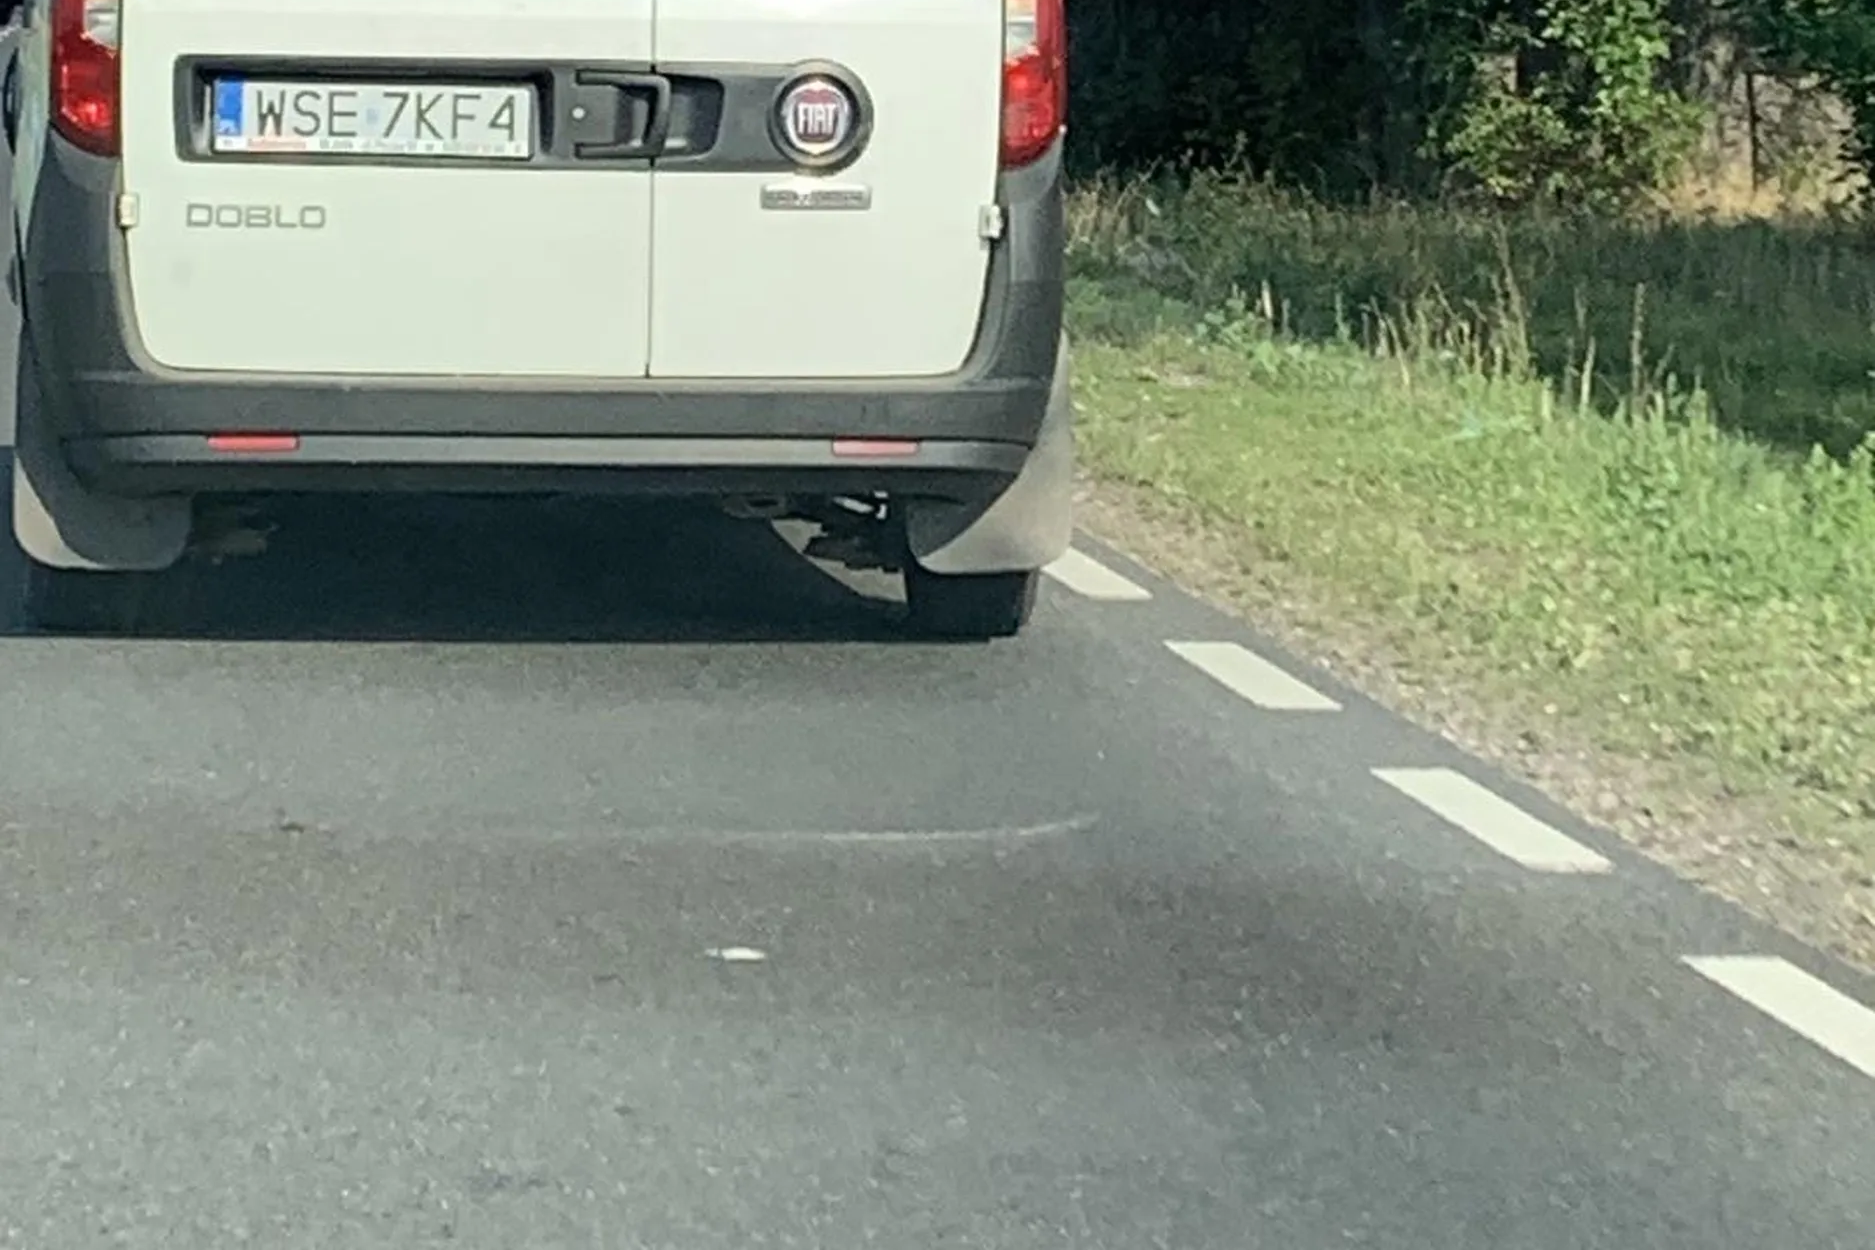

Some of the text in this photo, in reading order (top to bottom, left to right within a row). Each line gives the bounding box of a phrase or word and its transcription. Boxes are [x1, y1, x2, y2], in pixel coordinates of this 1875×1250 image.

[255, 89, 516, 141] WSE 7KF4
[797, 103, 837, 134] FIAT
[186, 203, 326, 229] DOBLO
